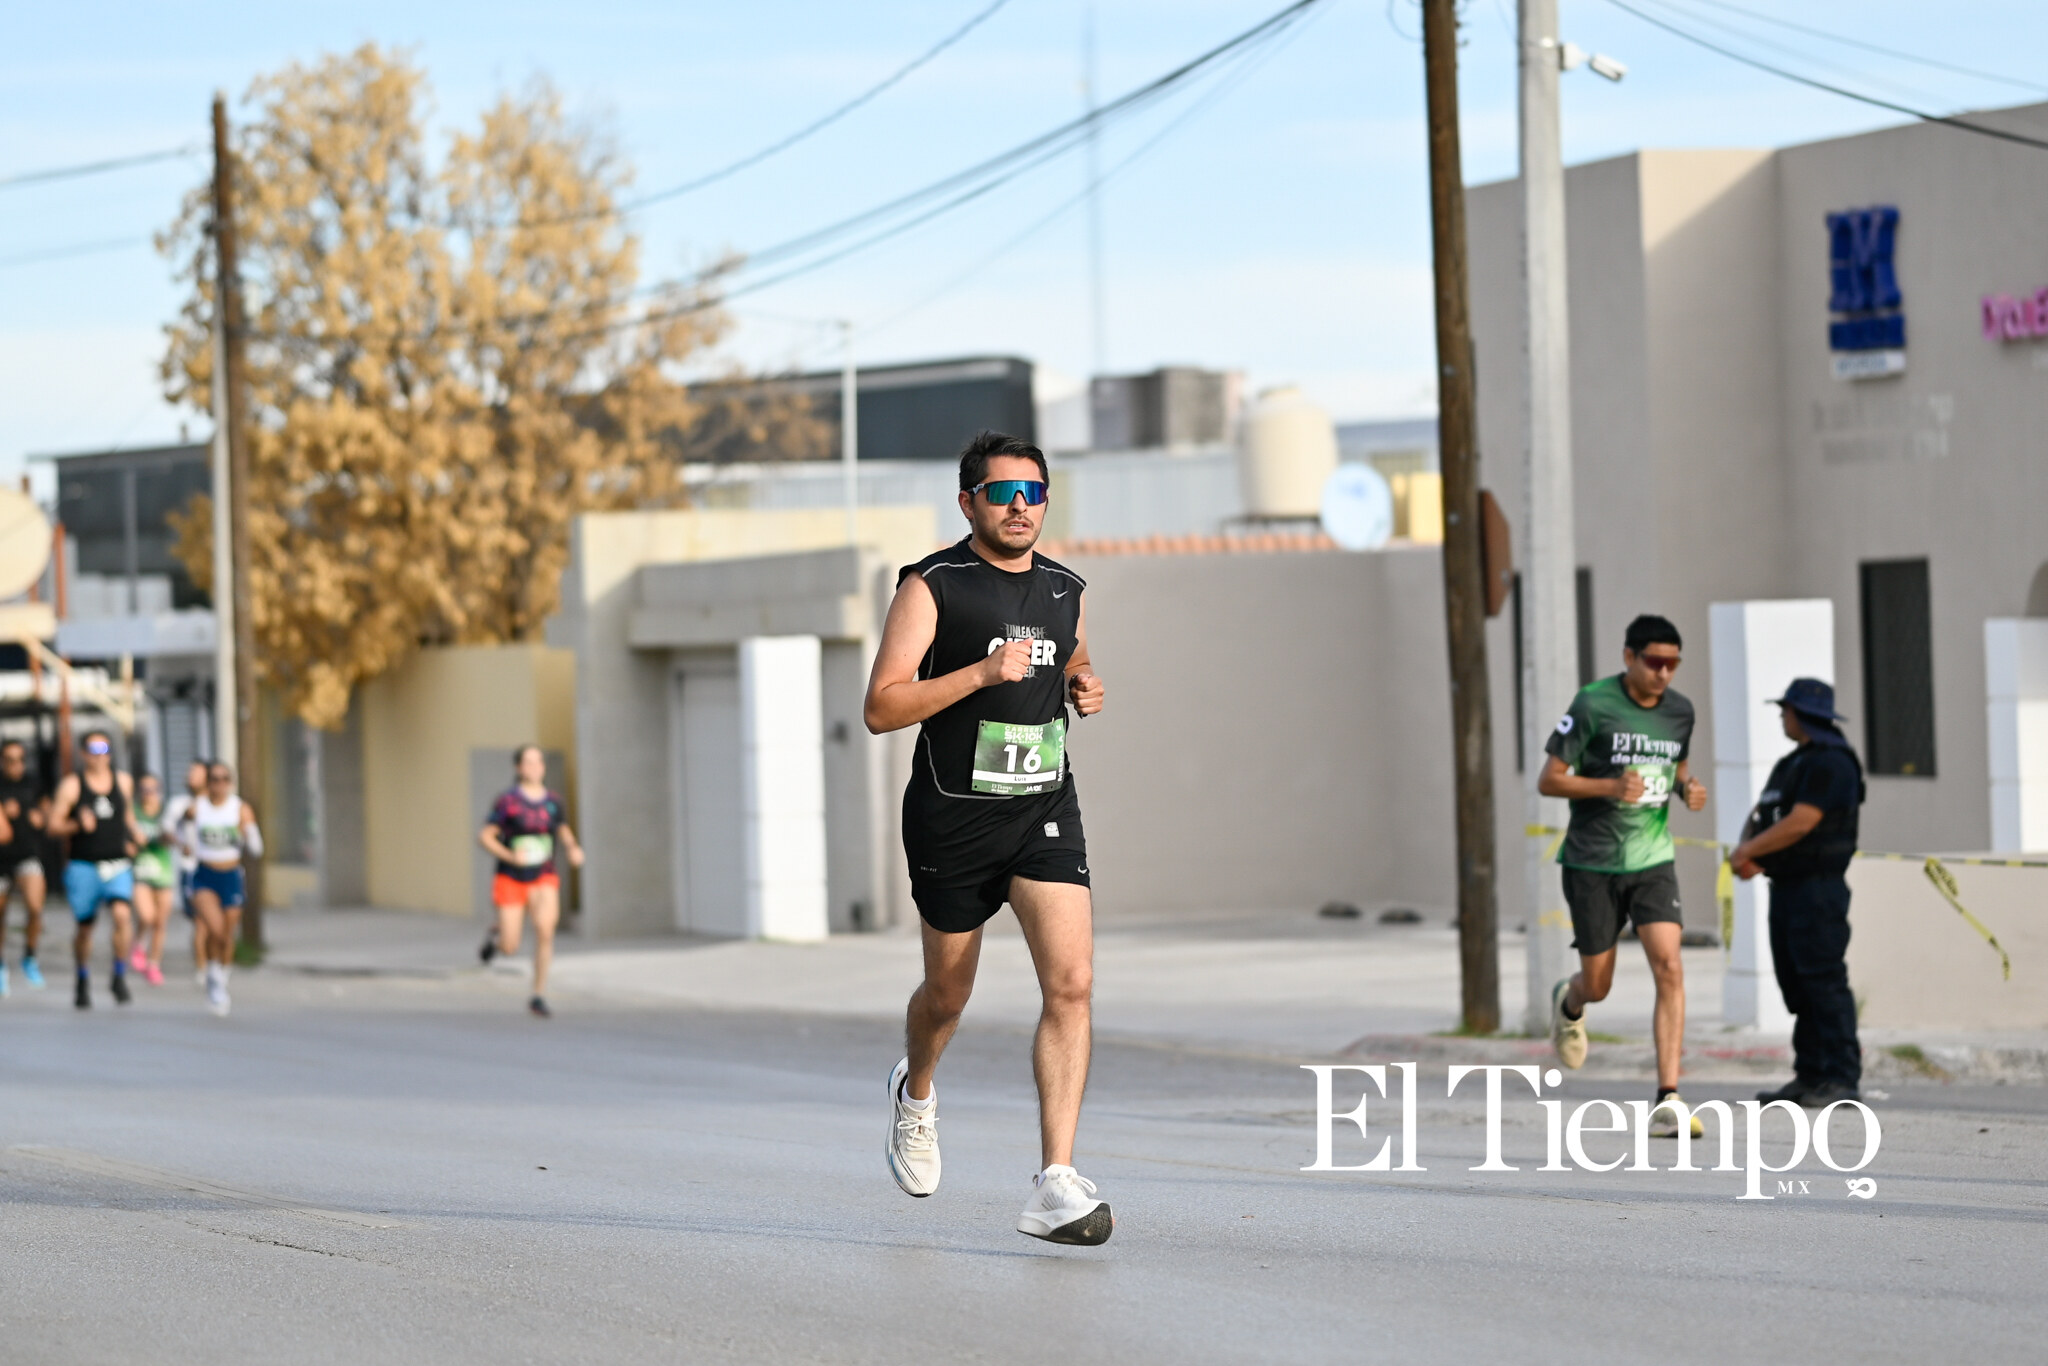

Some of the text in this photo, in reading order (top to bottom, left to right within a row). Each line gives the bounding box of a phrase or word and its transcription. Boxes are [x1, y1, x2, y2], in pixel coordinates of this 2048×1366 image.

[1006, 624, 1044, 638] UNLEASH
[1613, 733, 1681, 758] El Tiempo
[1003, 744, 1042, 774] 16
[1610, 753, 1631, 764] de
